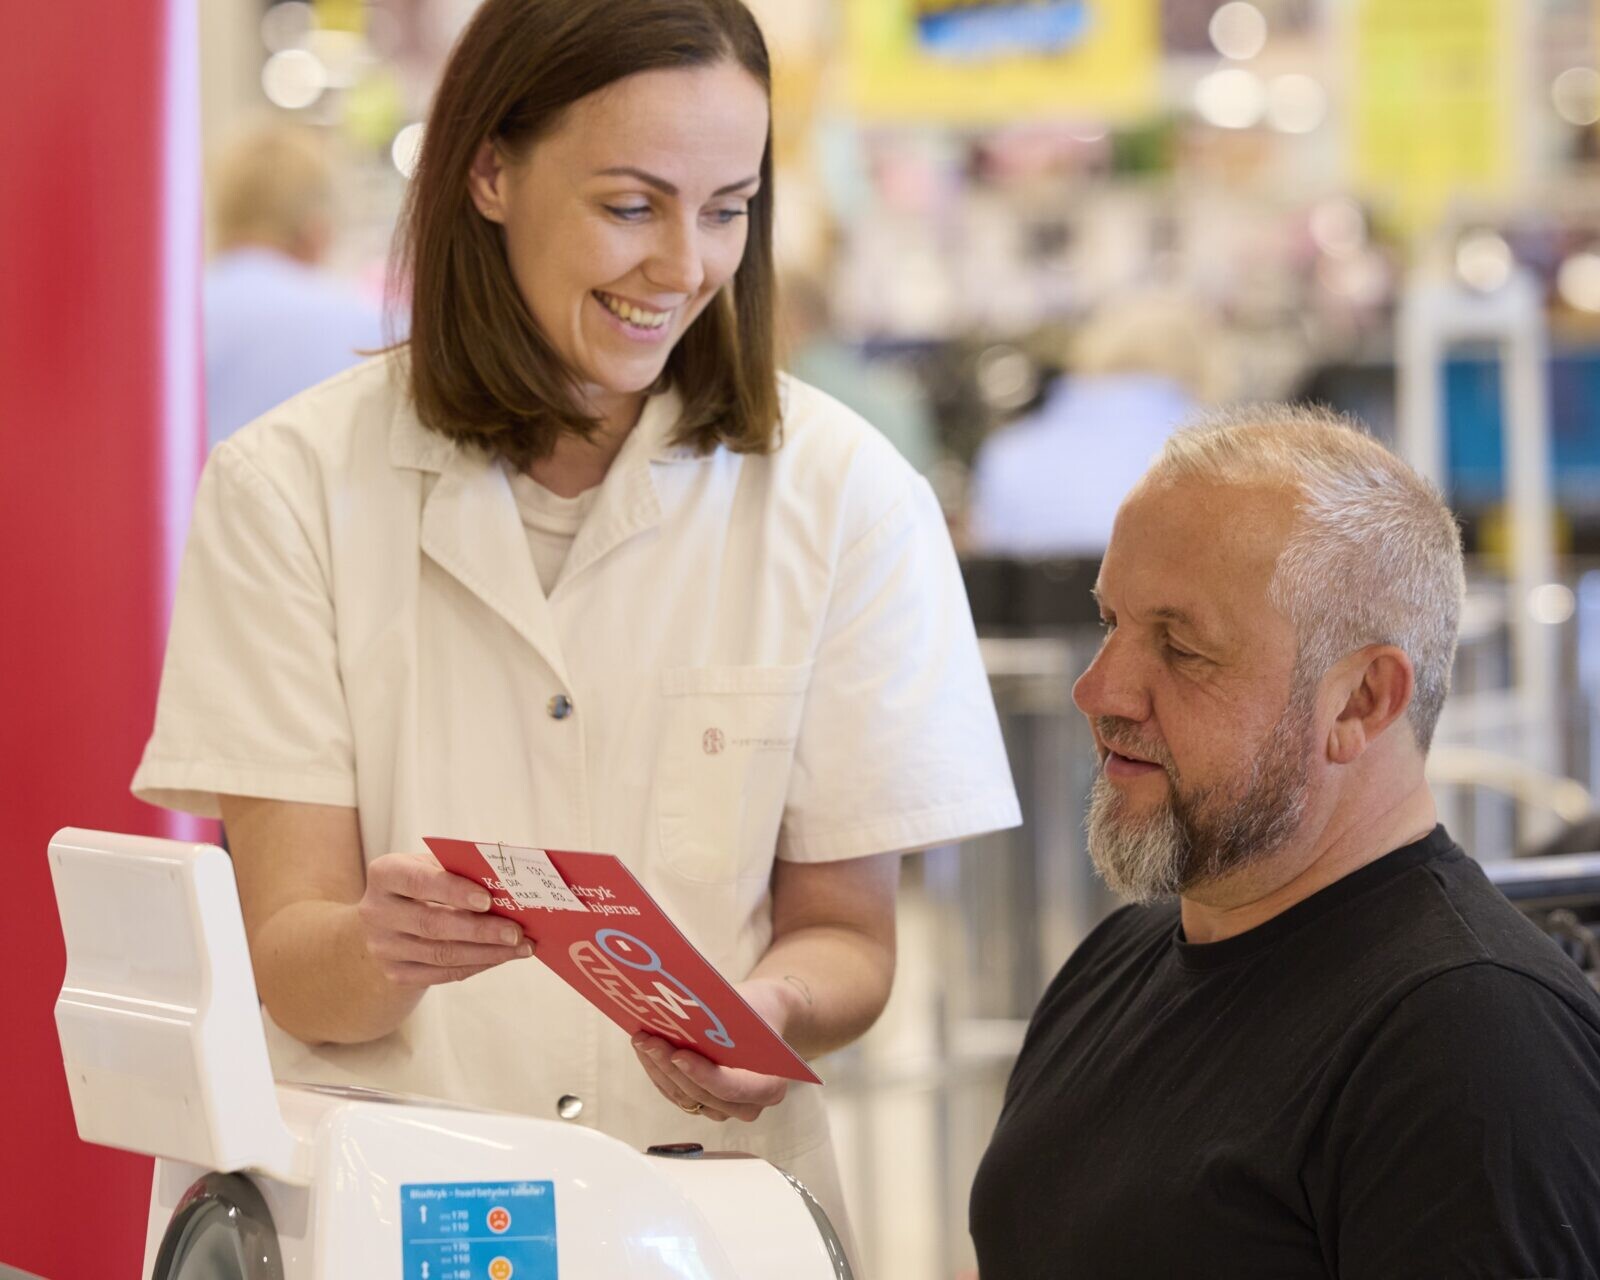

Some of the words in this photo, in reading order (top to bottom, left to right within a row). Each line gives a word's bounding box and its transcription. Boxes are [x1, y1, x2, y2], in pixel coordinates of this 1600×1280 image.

[481, 877, 507, 890] Ke
[570, 884, 617, 901] dtryk
[493, 897, 515, 911] og
[586, 901, 641, 916] hjerne
